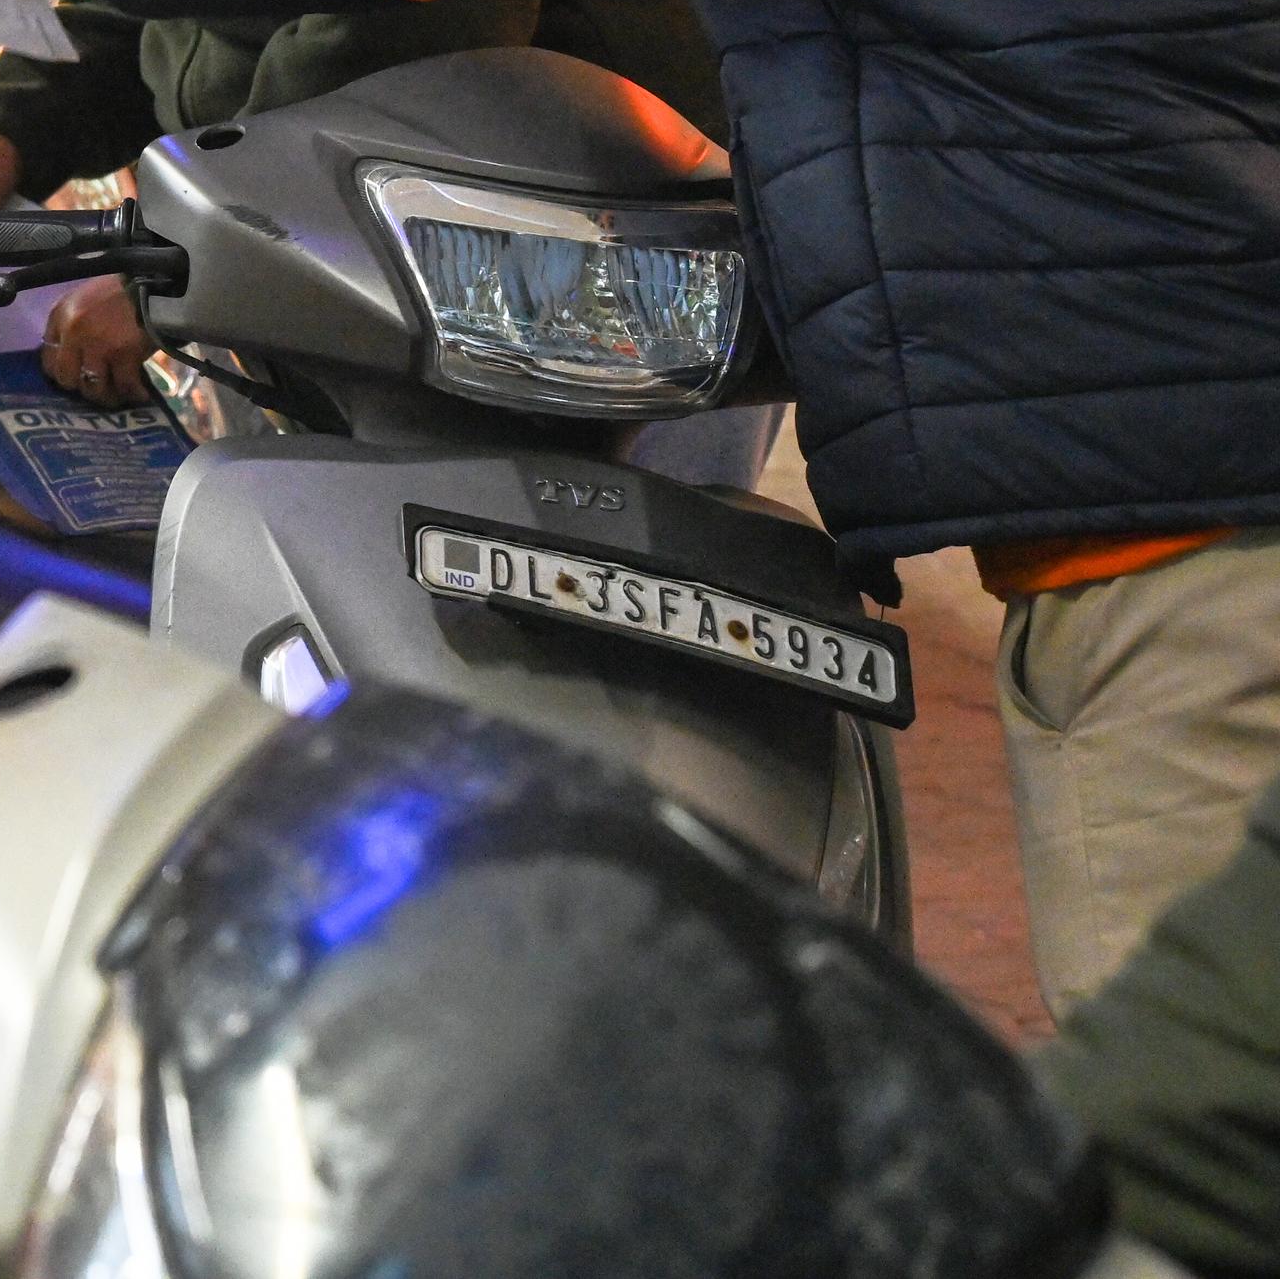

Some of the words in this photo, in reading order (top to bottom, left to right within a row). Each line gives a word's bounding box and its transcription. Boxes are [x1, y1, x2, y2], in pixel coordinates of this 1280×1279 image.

[13, 411, 74, 428] OM
[78, 411, 157, 430] TVS
[535, 479, 625, 512] TVS
[443, 570, 475, 589] IND
[751, 617, 879, 694] 5934
